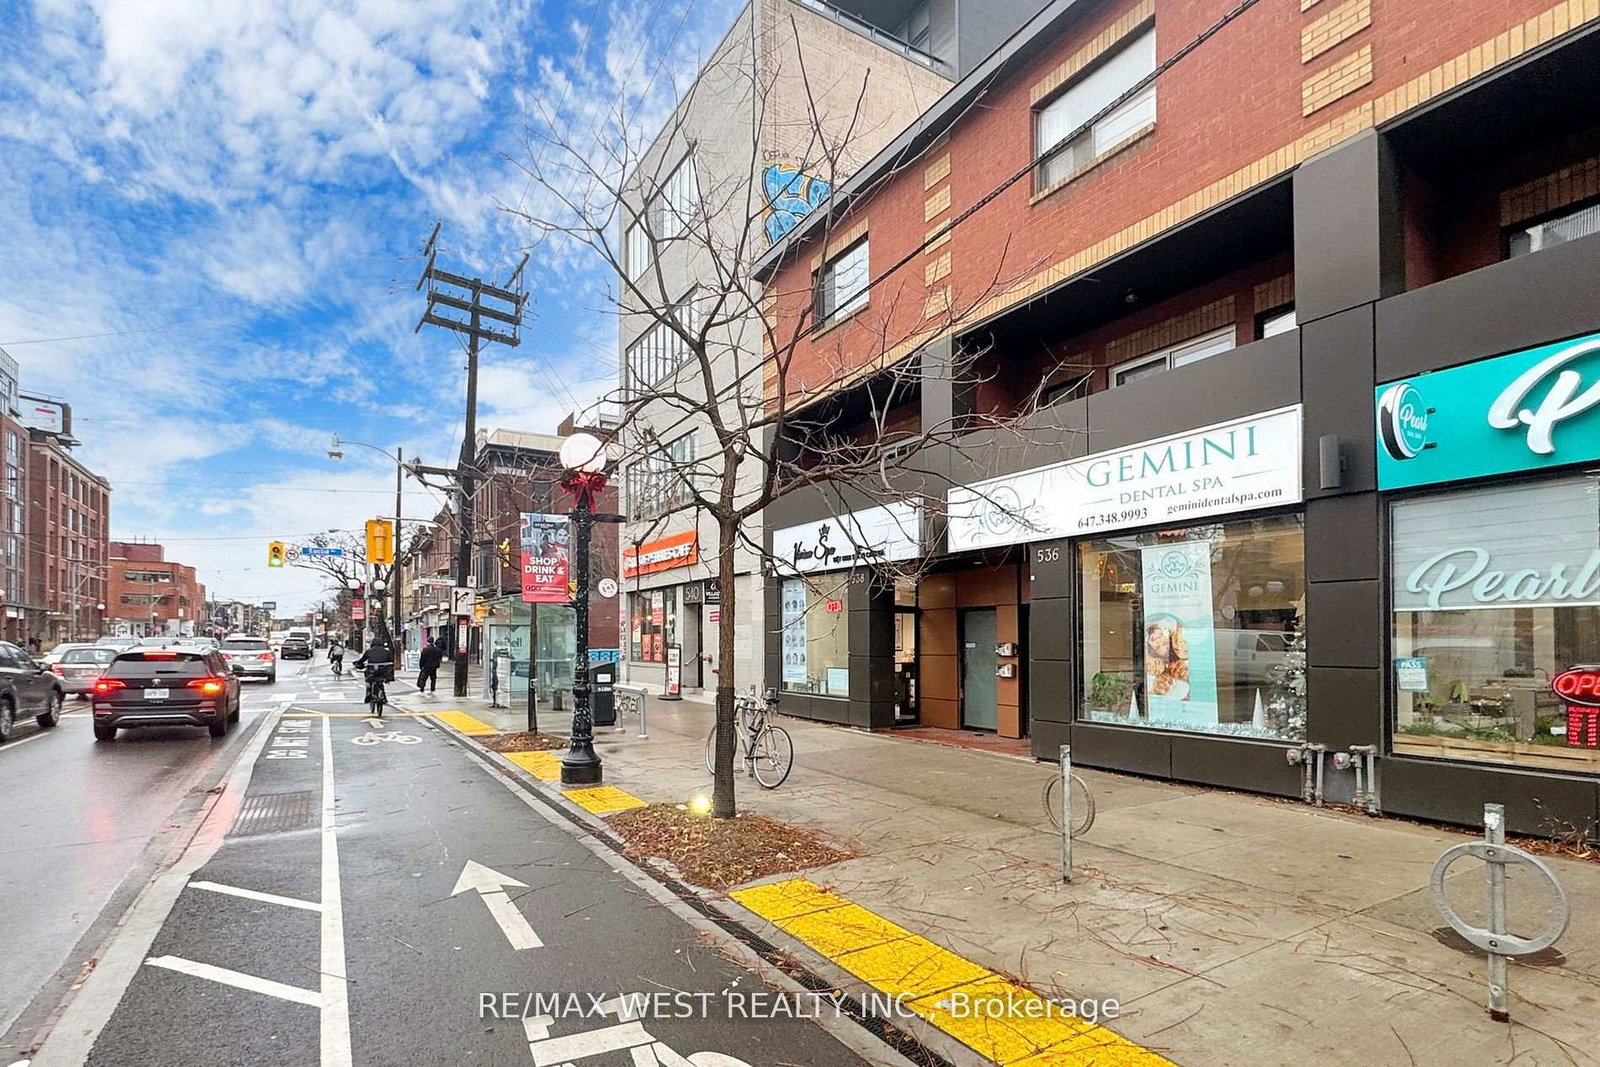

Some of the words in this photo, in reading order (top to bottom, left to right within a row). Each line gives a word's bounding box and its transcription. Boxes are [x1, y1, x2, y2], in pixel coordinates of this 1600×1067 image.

[1400, 403, 1428, 431] Pearl
[1086, 425, 1261, 487] GEMINI
[1119, 482, 1187, 505] DENTAL
[1191, 475, 1224, 493] SPA
[1077, 507, 1148, 529] 647.348.9993
[1167, 488, 1283, 515] geminidentalspa.com
[1037, 547, 1060, 563] 536
[524, 565, 556, 575] DRINK
[557, 566, 565, 575] &
[535, 574, 554, 583] EAT
[1151, 580, 1199, 594] GEMINI
